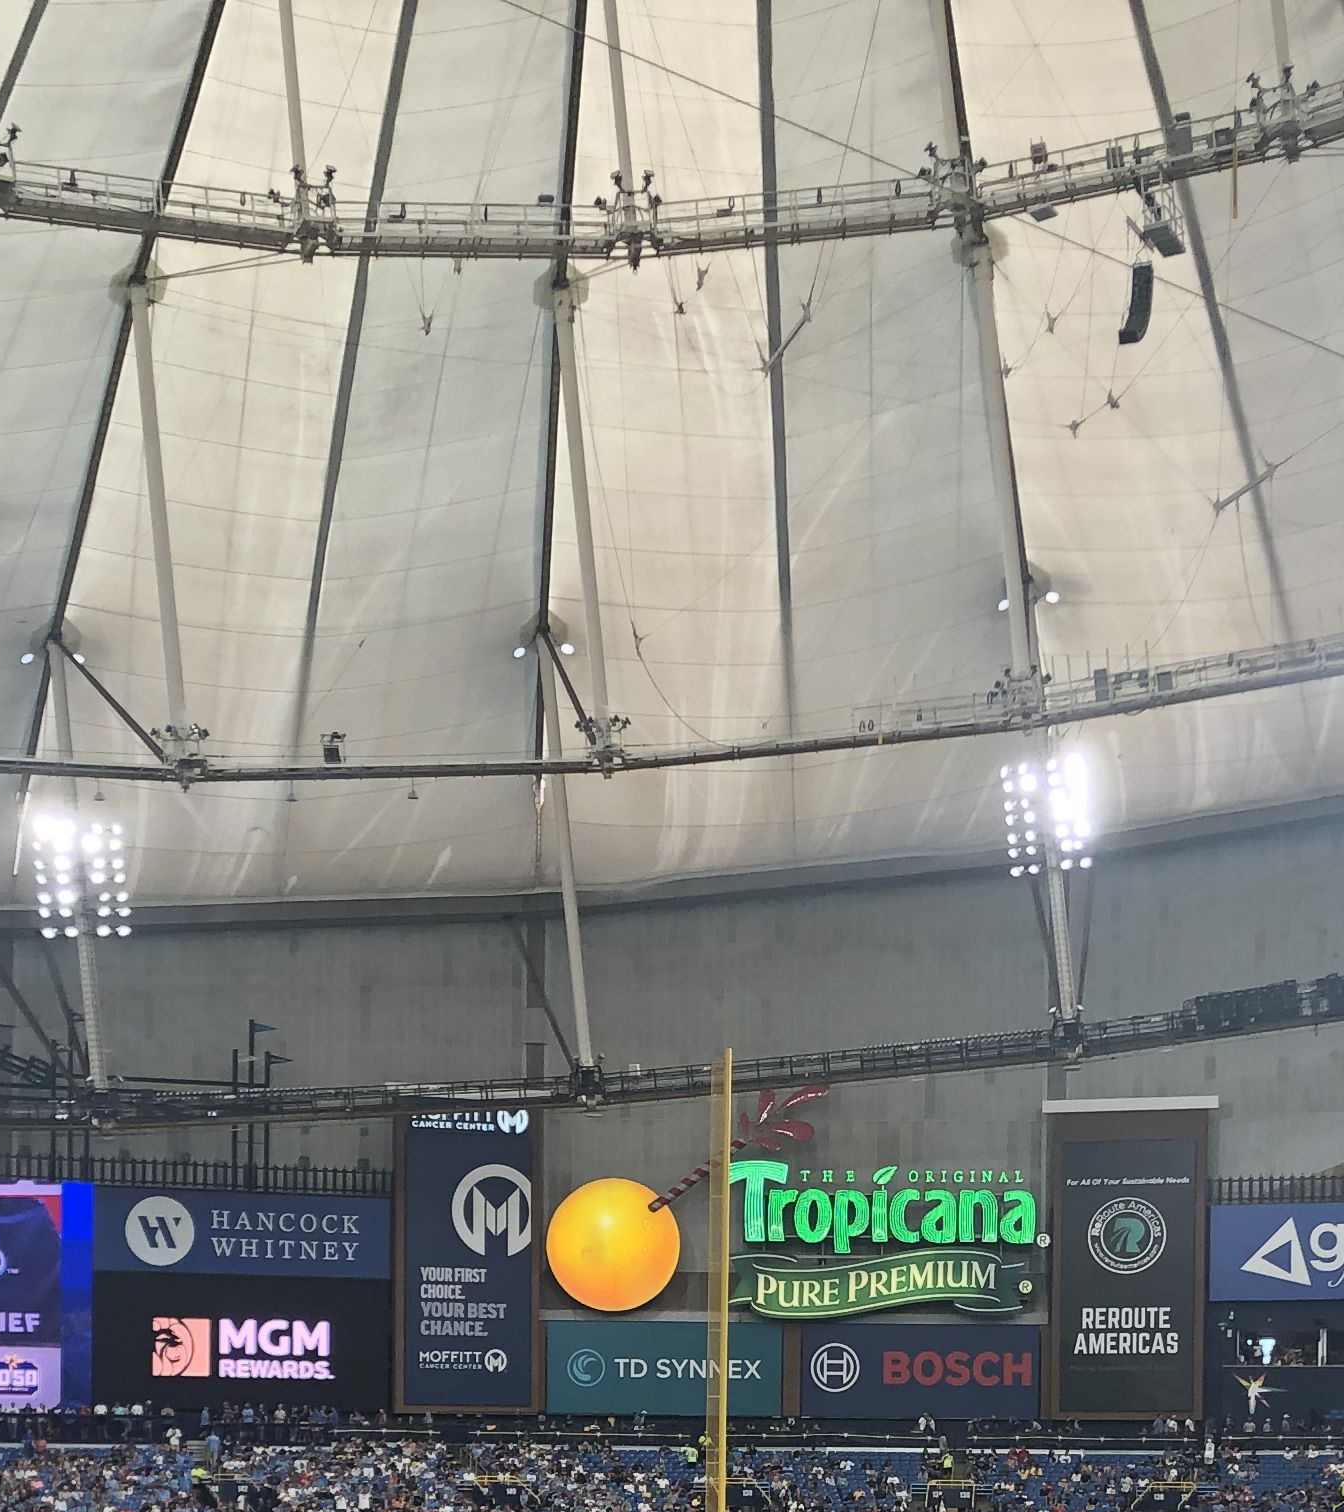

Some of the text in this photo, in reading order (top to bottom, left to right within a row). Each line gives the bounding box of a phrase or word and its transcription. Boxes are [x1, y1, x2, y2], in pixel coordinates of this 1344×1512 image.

[412, 1120, 495, 1131] CANCER CENTER
[801, 1170, 1025, 1183] THE ORIGINAL
[728, 1160, 1037, 1254] Tropicana
[211, 1209, 359, 1235] HANCOCK
[1091, 1200, 1162, 1238] ReRoute Americas
[211, 1237, 359, 1261] WHITNEY
[420, 1266, 487, 1282] YOUR FIRST
[756, 1261, 997, 1308] PURE PREMIUM
[420, 1284, 465, 1299] CHOICE.
[420, 1302, 507, 1318] YOUR BEST
[1082, 1307, 1171, 1329] REROUTE
[219, 1318, 330, 1357] MGM
[420, 1320, 488, 1336] CHANCE.
[1074, 1332, 1179, 1354] AMERICAS
[420, 1351, 482, 1363] MOFFITT
[614, 1358, 762, 1379] TD SYNNEX
[882, 1352, 1033, 1387] BOSCH
